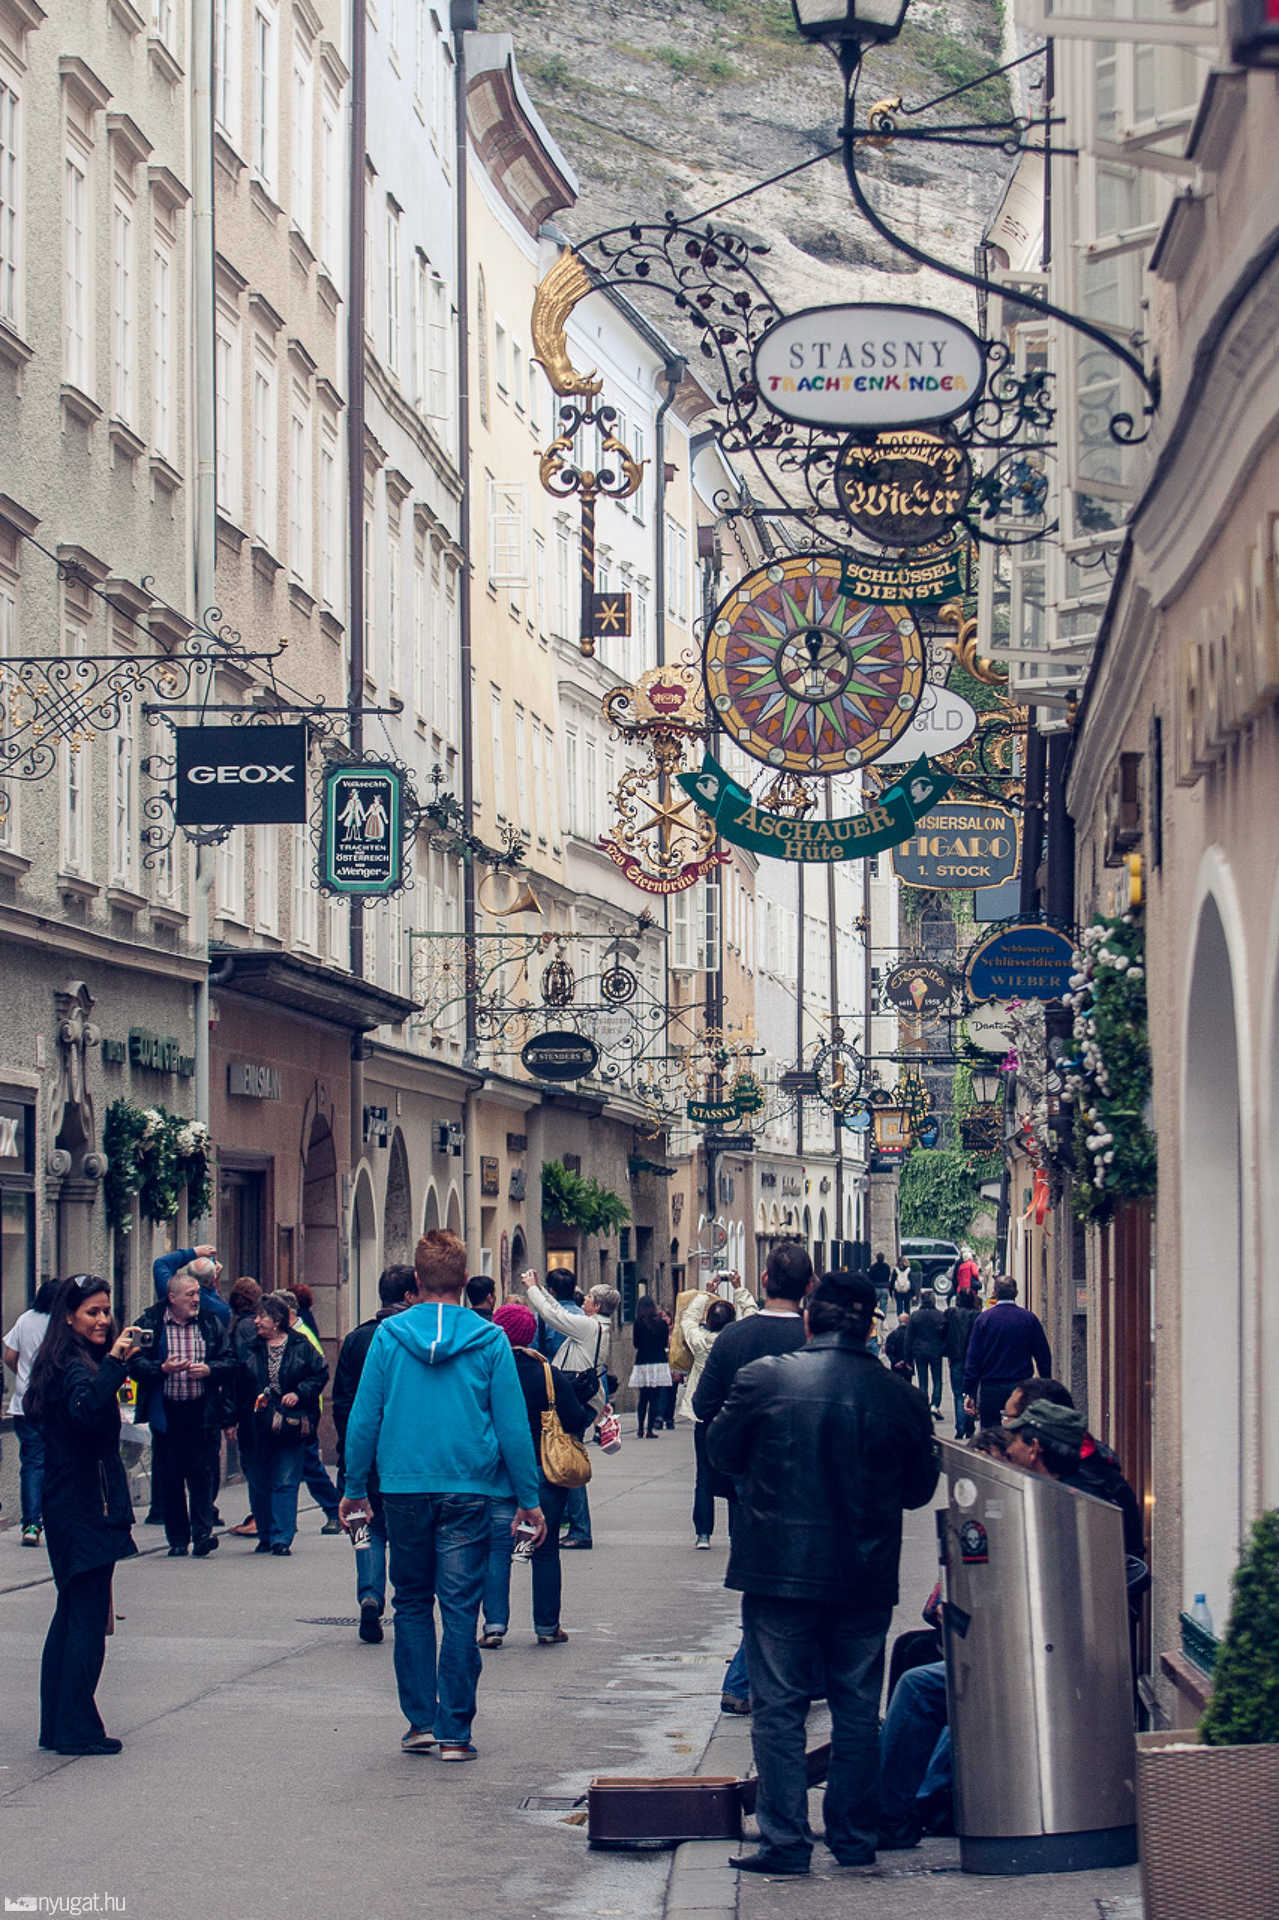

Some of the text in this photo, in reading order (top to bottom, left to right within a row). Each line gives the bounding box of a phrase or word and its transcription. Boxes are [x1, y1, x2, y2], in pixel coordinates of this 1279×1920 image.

[789, 341, 948, 370] STASSNY
[768, 372, 968, 392] TRACHTENKINDER
[846, 561, 957, 585] SCHLÜSSEL
[853, 580, 944, 600] DIENST
[187, 765, 295, 784] GEOX
[733, 806, 895, 841] ASCHAUER
[913, 814, 1006, 831] RISIERSALON
[782, 840, 844, 860] Hüte
[899, 835, 1011, 859] FIGARO
[917, 865, 991, 877] 1. STOCK
[991, 975, 1061, 987] WIEBER
[692, 1105, 737, 1120] STASSNY
